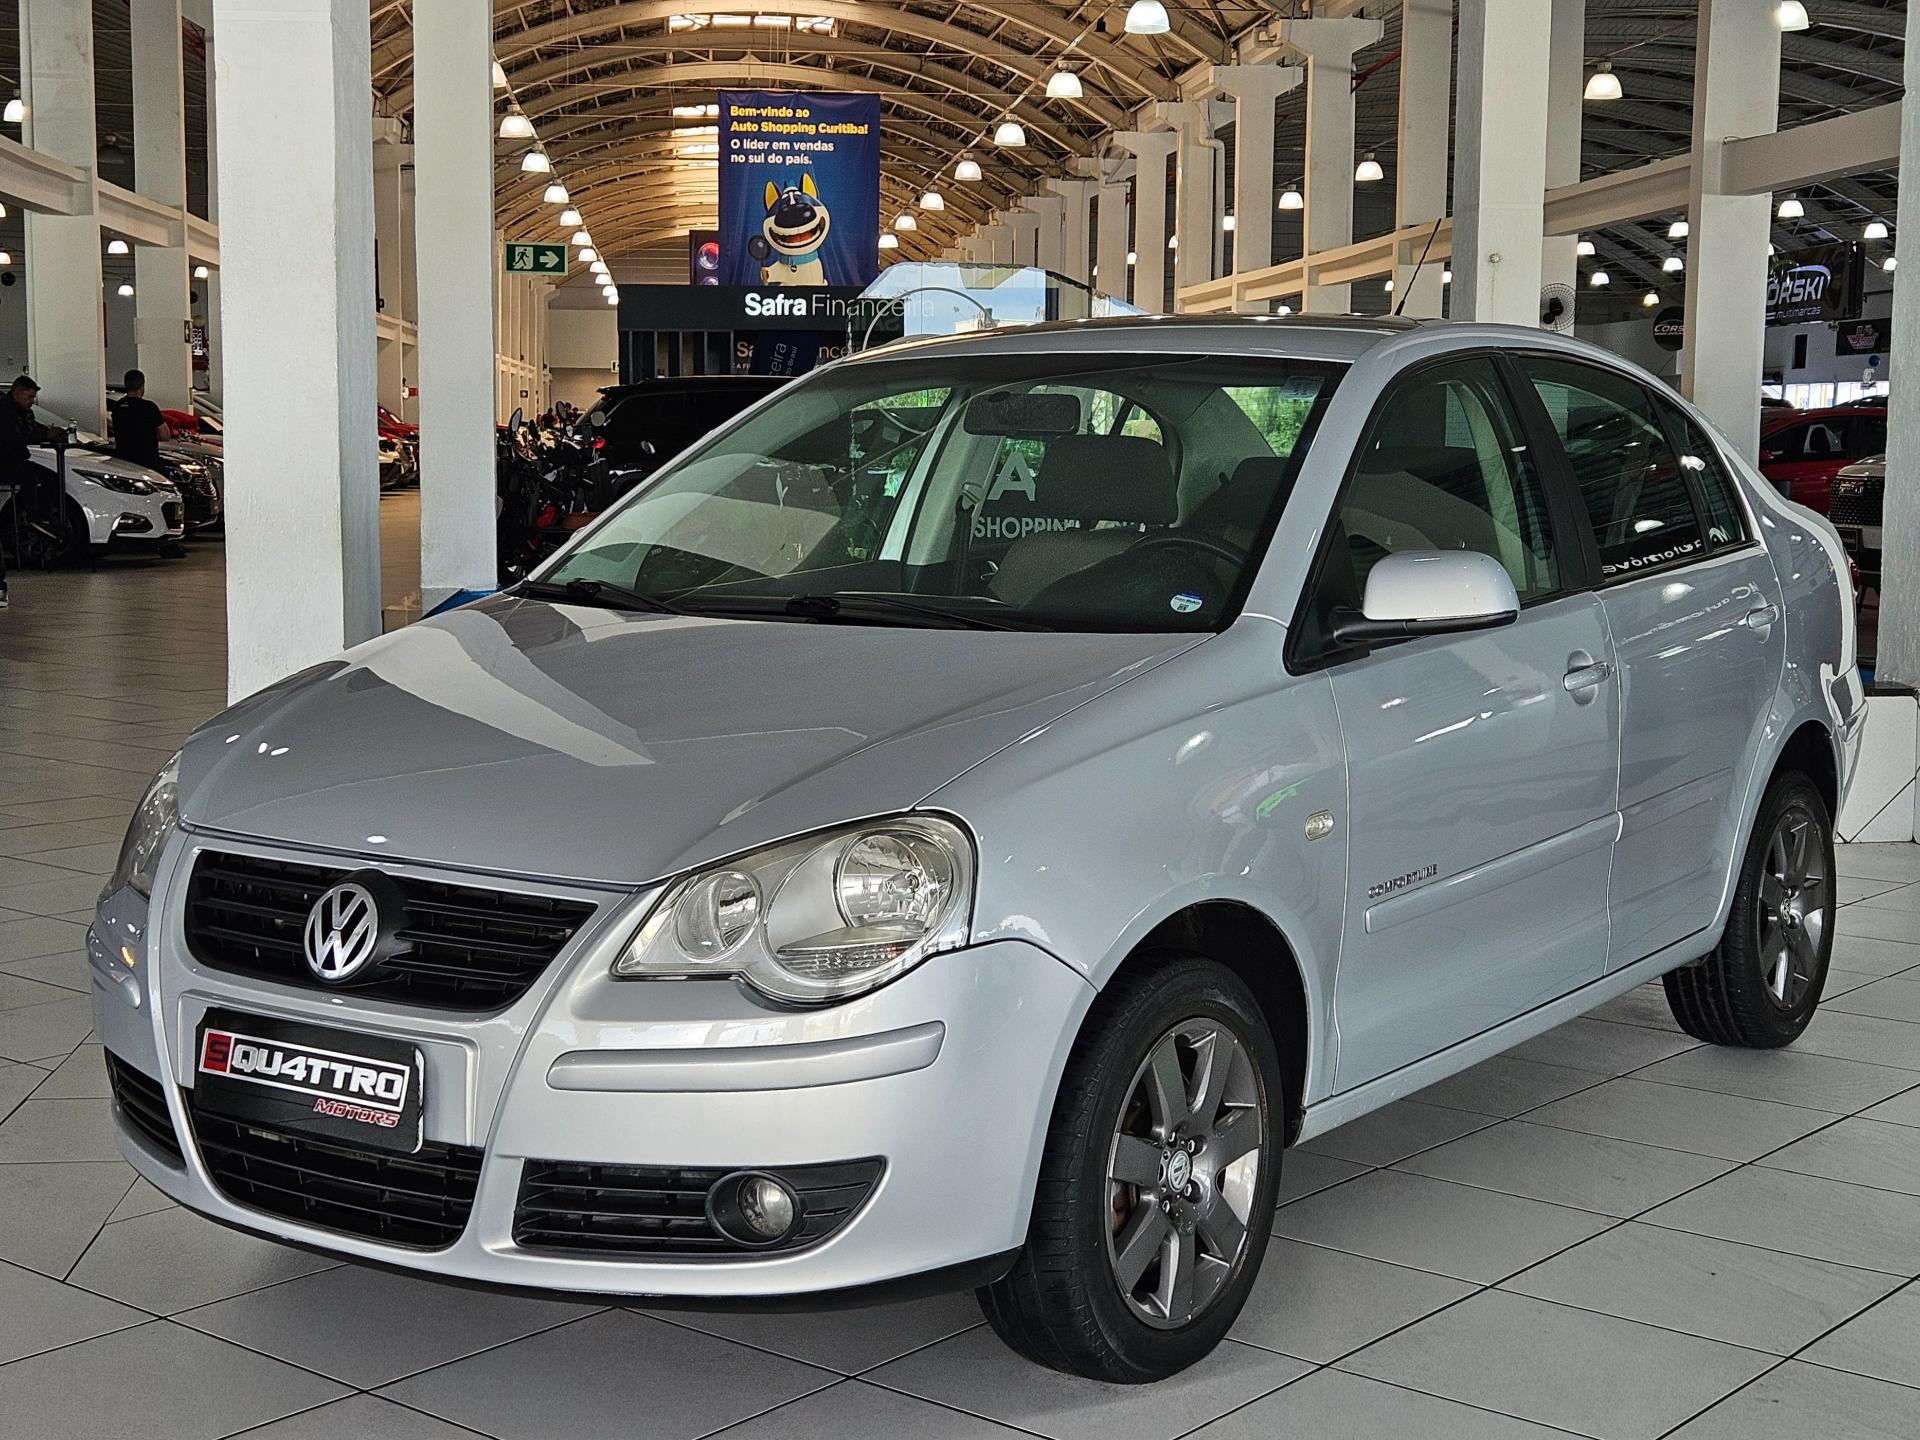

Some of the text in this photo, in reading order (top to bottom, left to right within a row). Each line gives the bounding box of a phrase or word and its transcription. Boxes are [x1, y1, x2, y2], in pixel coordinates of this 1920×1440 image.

[730, 105, 810, 118] Bem-vindo ao
[730, 121, 869, 135] Auto Shopping Curitiba!
[730, 138, 834, 151] O líder em vendas
[730, 152, 813, 166] no sul do país.
[1766, 275, 1824, 306] ORSKI
[744, 292, 807, 316] Safra
[1654, 324, 1684, 332] CORS
[313, 1098, 400, 1128] MOTORS
